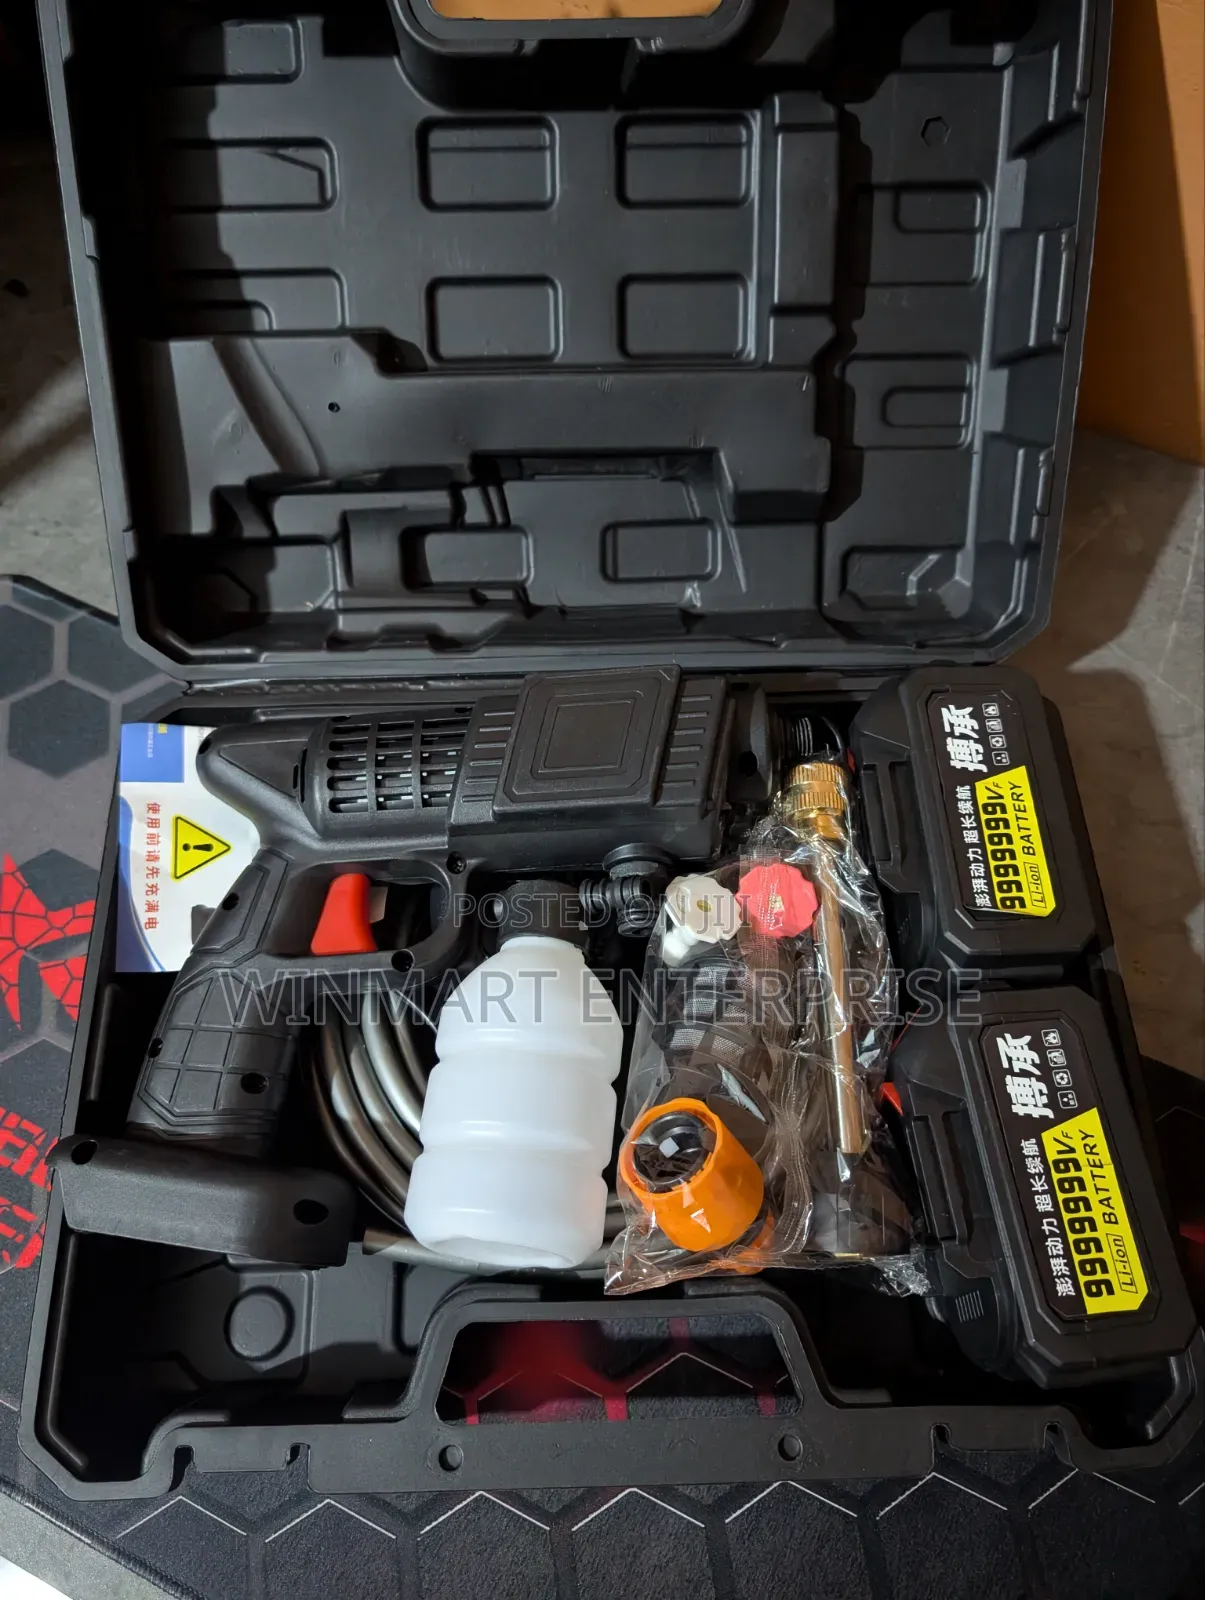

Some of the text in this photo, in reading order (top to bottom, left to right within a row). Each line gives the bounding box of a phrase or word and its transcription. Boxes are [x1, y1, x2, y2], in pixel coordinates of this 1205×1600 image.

[144, 801, 161, 930] 使用前请先充满电
[955, 785, 992, 907] 澎湃动力 超长续航
[1008, 781, 1036, 857] BATTERY
[1021, 1138, 1076, 1297] 澎湃动力 超长续航
[1079, 1129, 1135, 1287] Li-ion BATTERY
